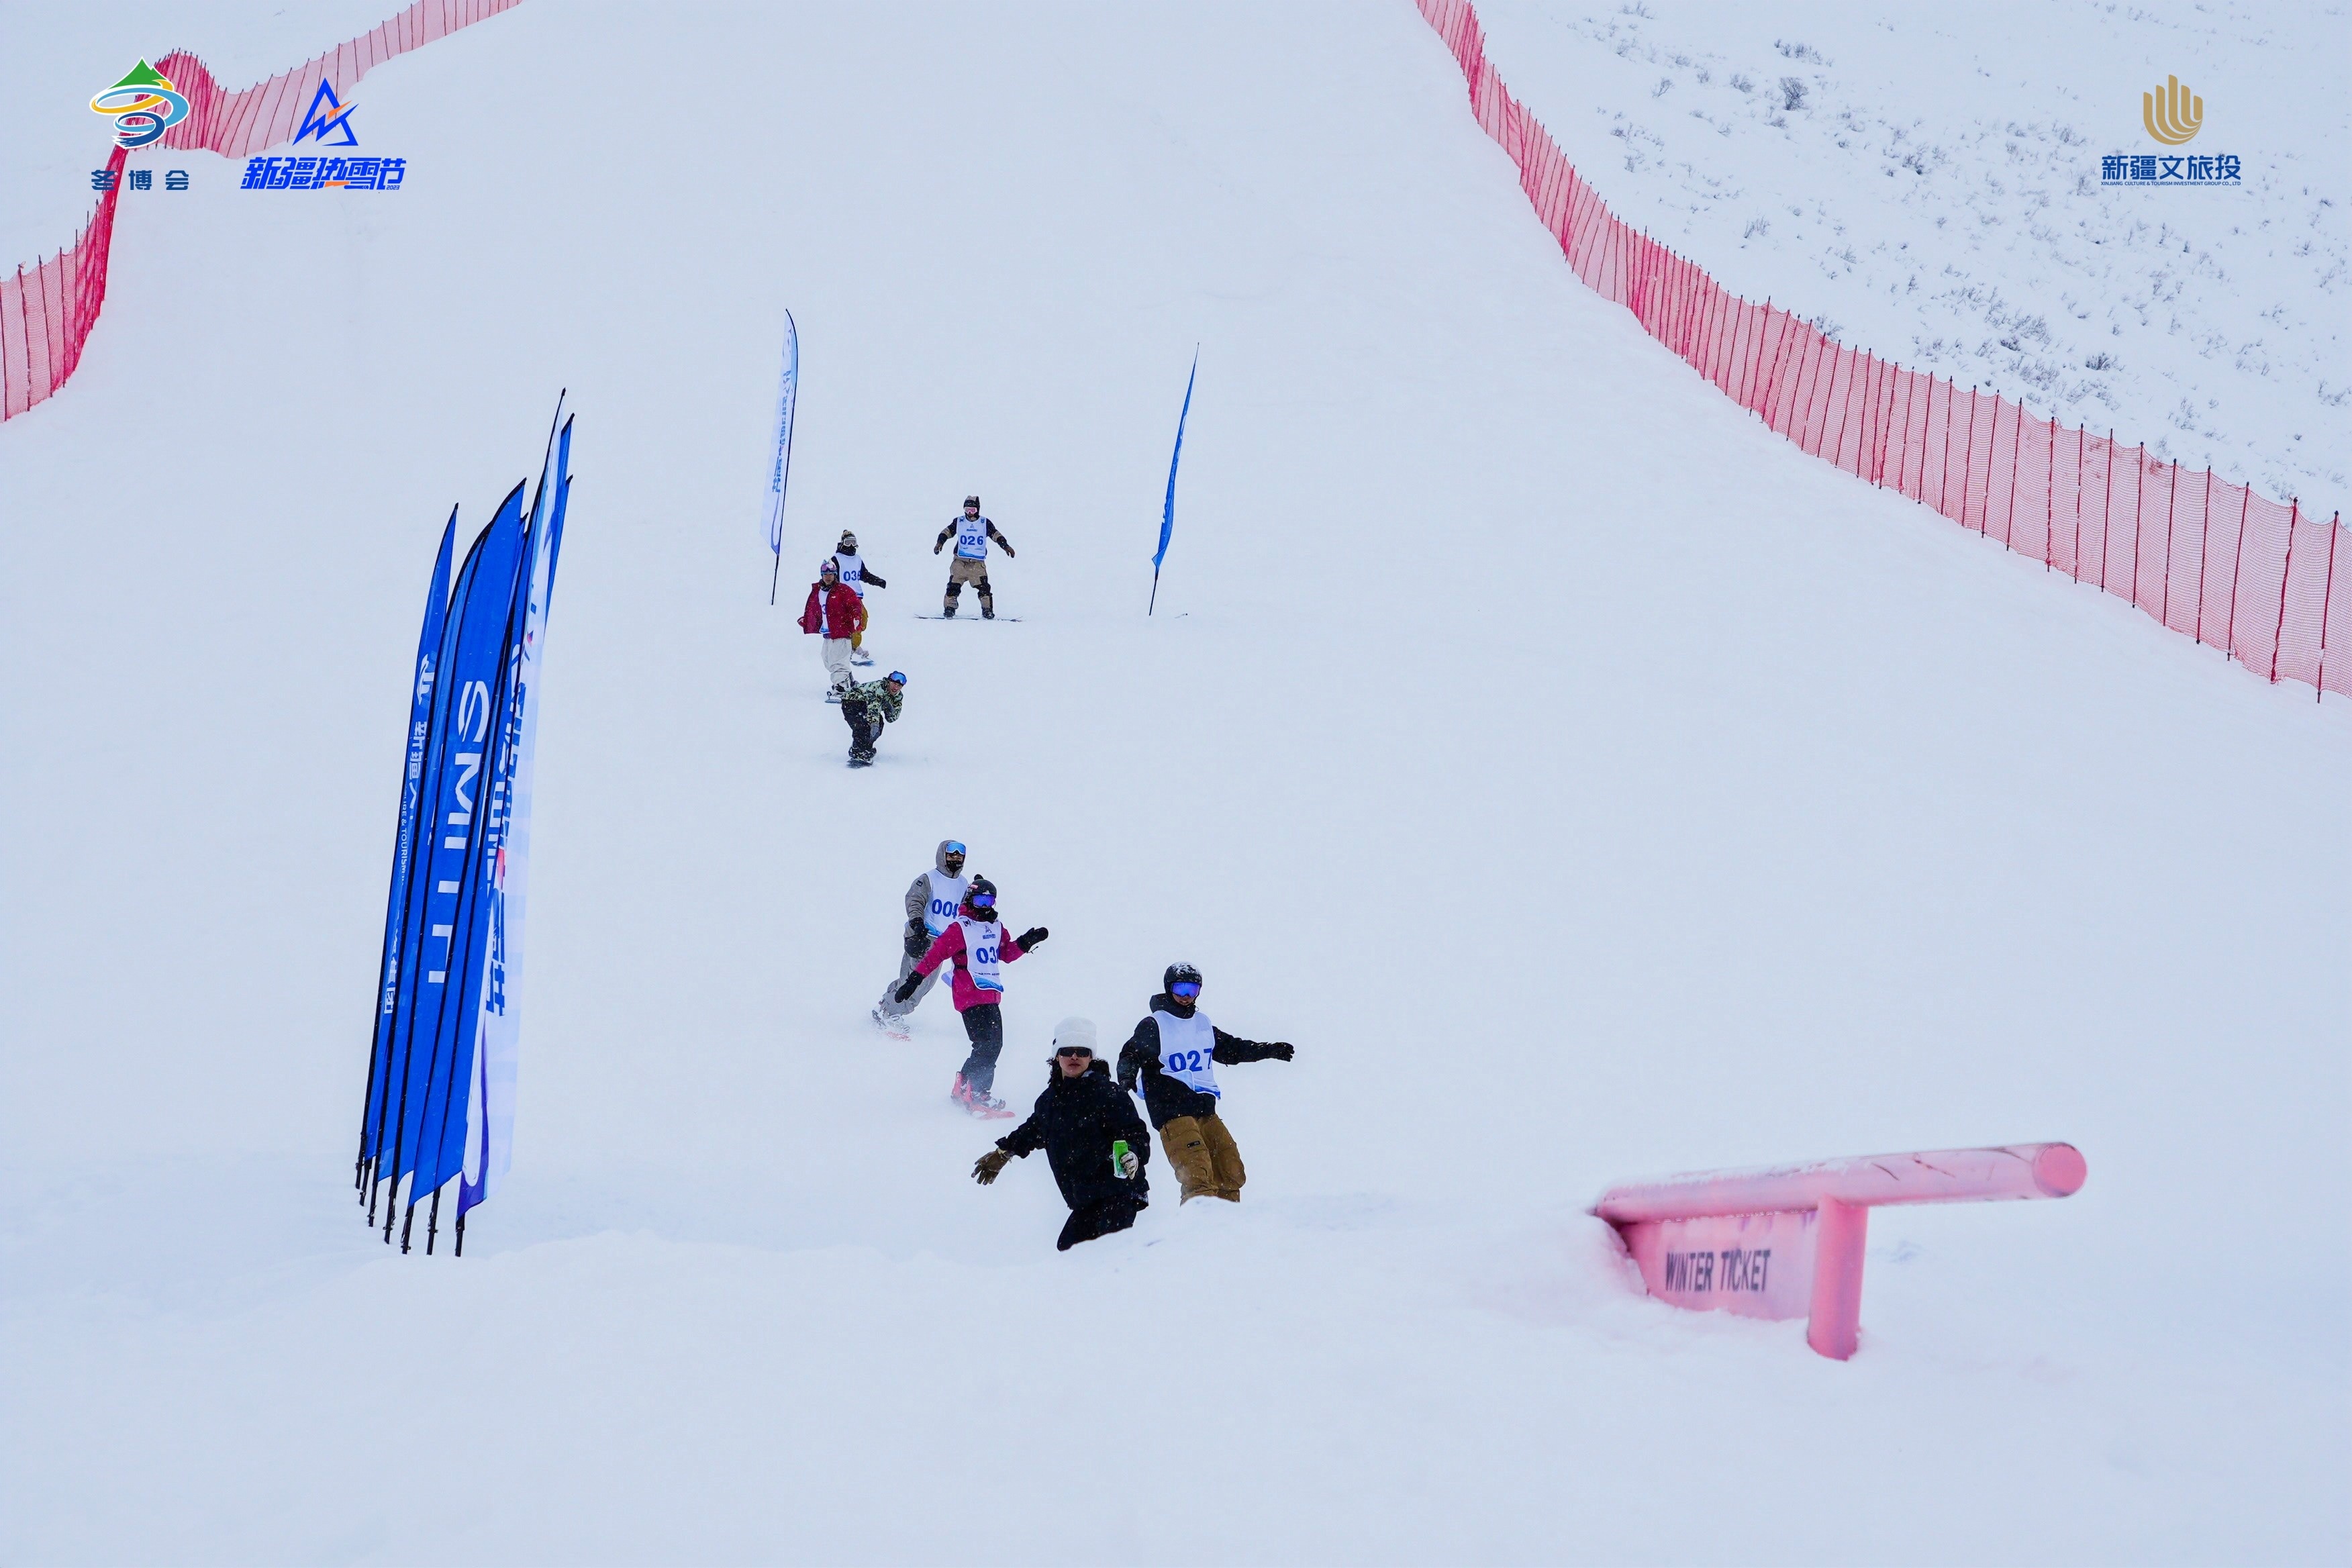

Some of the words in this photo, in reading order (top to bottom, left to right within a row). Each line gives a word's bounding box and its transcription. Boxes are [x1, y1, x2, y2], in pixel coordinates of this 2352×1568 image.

[960, 535, 983, 546] 026
[976, 946, 999, 964] 03
[1169, 1048, 1212, 1073] 027
[1665, 1251, 1714, 1292] WINTER
[1720, 1248, 1771, 1292] TICKET
